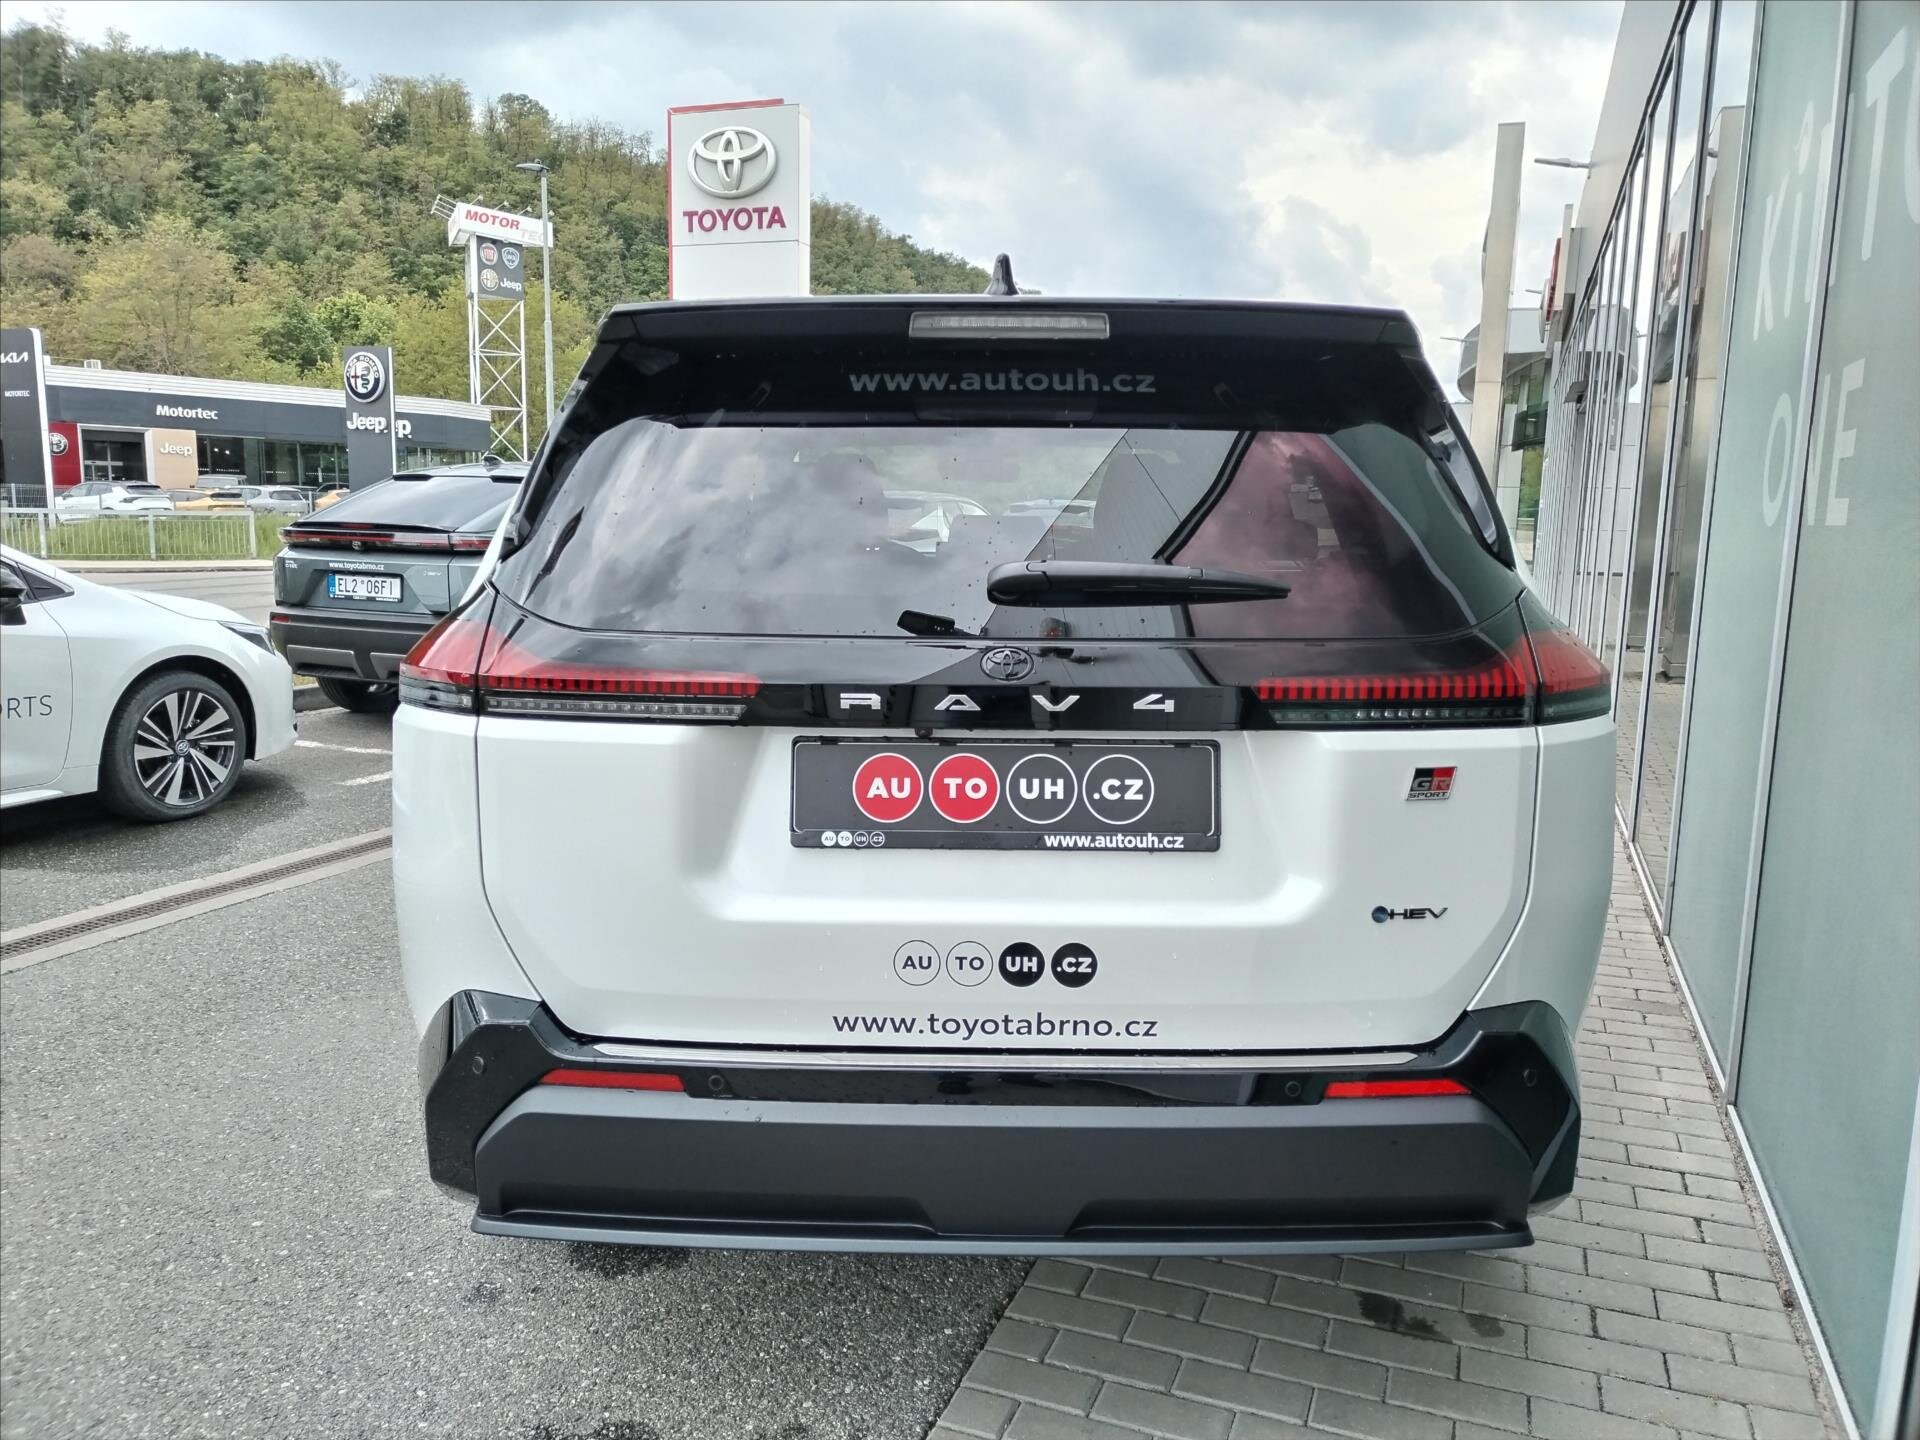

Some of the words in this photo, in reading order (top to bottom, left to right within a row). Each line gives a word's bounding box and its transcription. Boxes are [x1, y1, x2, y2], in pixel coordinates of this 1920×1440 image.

[465, 210, 521, 230] MOTOR
[682, 206, 787, 233] TOYOTA
[500, 277, 522, 292] Jeep
[0, 352, 28, 363] KIA
[849, 368, 1157, 394] www.autouh.cz
[155, 404, 219, 420] Motortec
[160, 442, 193, 457] Jeep
[337, 578, 358, 594] EL2
[0, 694, 53, 720] RTS
[840, 692, 1175, 713] RAV4
[866, 777, 911, 799] AU
[943, 777, 988, 800] TO
[1019, 777, 1065, 800] UH
[1410, 777, 1452, 791] GR
[1407, 791, 1448, 799] SPORT
[1043, 832, 1185, 849] www.autouh.cz
[1389, 907, 1449, 920] HEV
[902, 955, 933, 970] AU
[954, 956, 985, 971] TO
[1005, 956, 1038, 972] UH
[832, 1011, 1158, 1041] www.toyotabrno.cz
